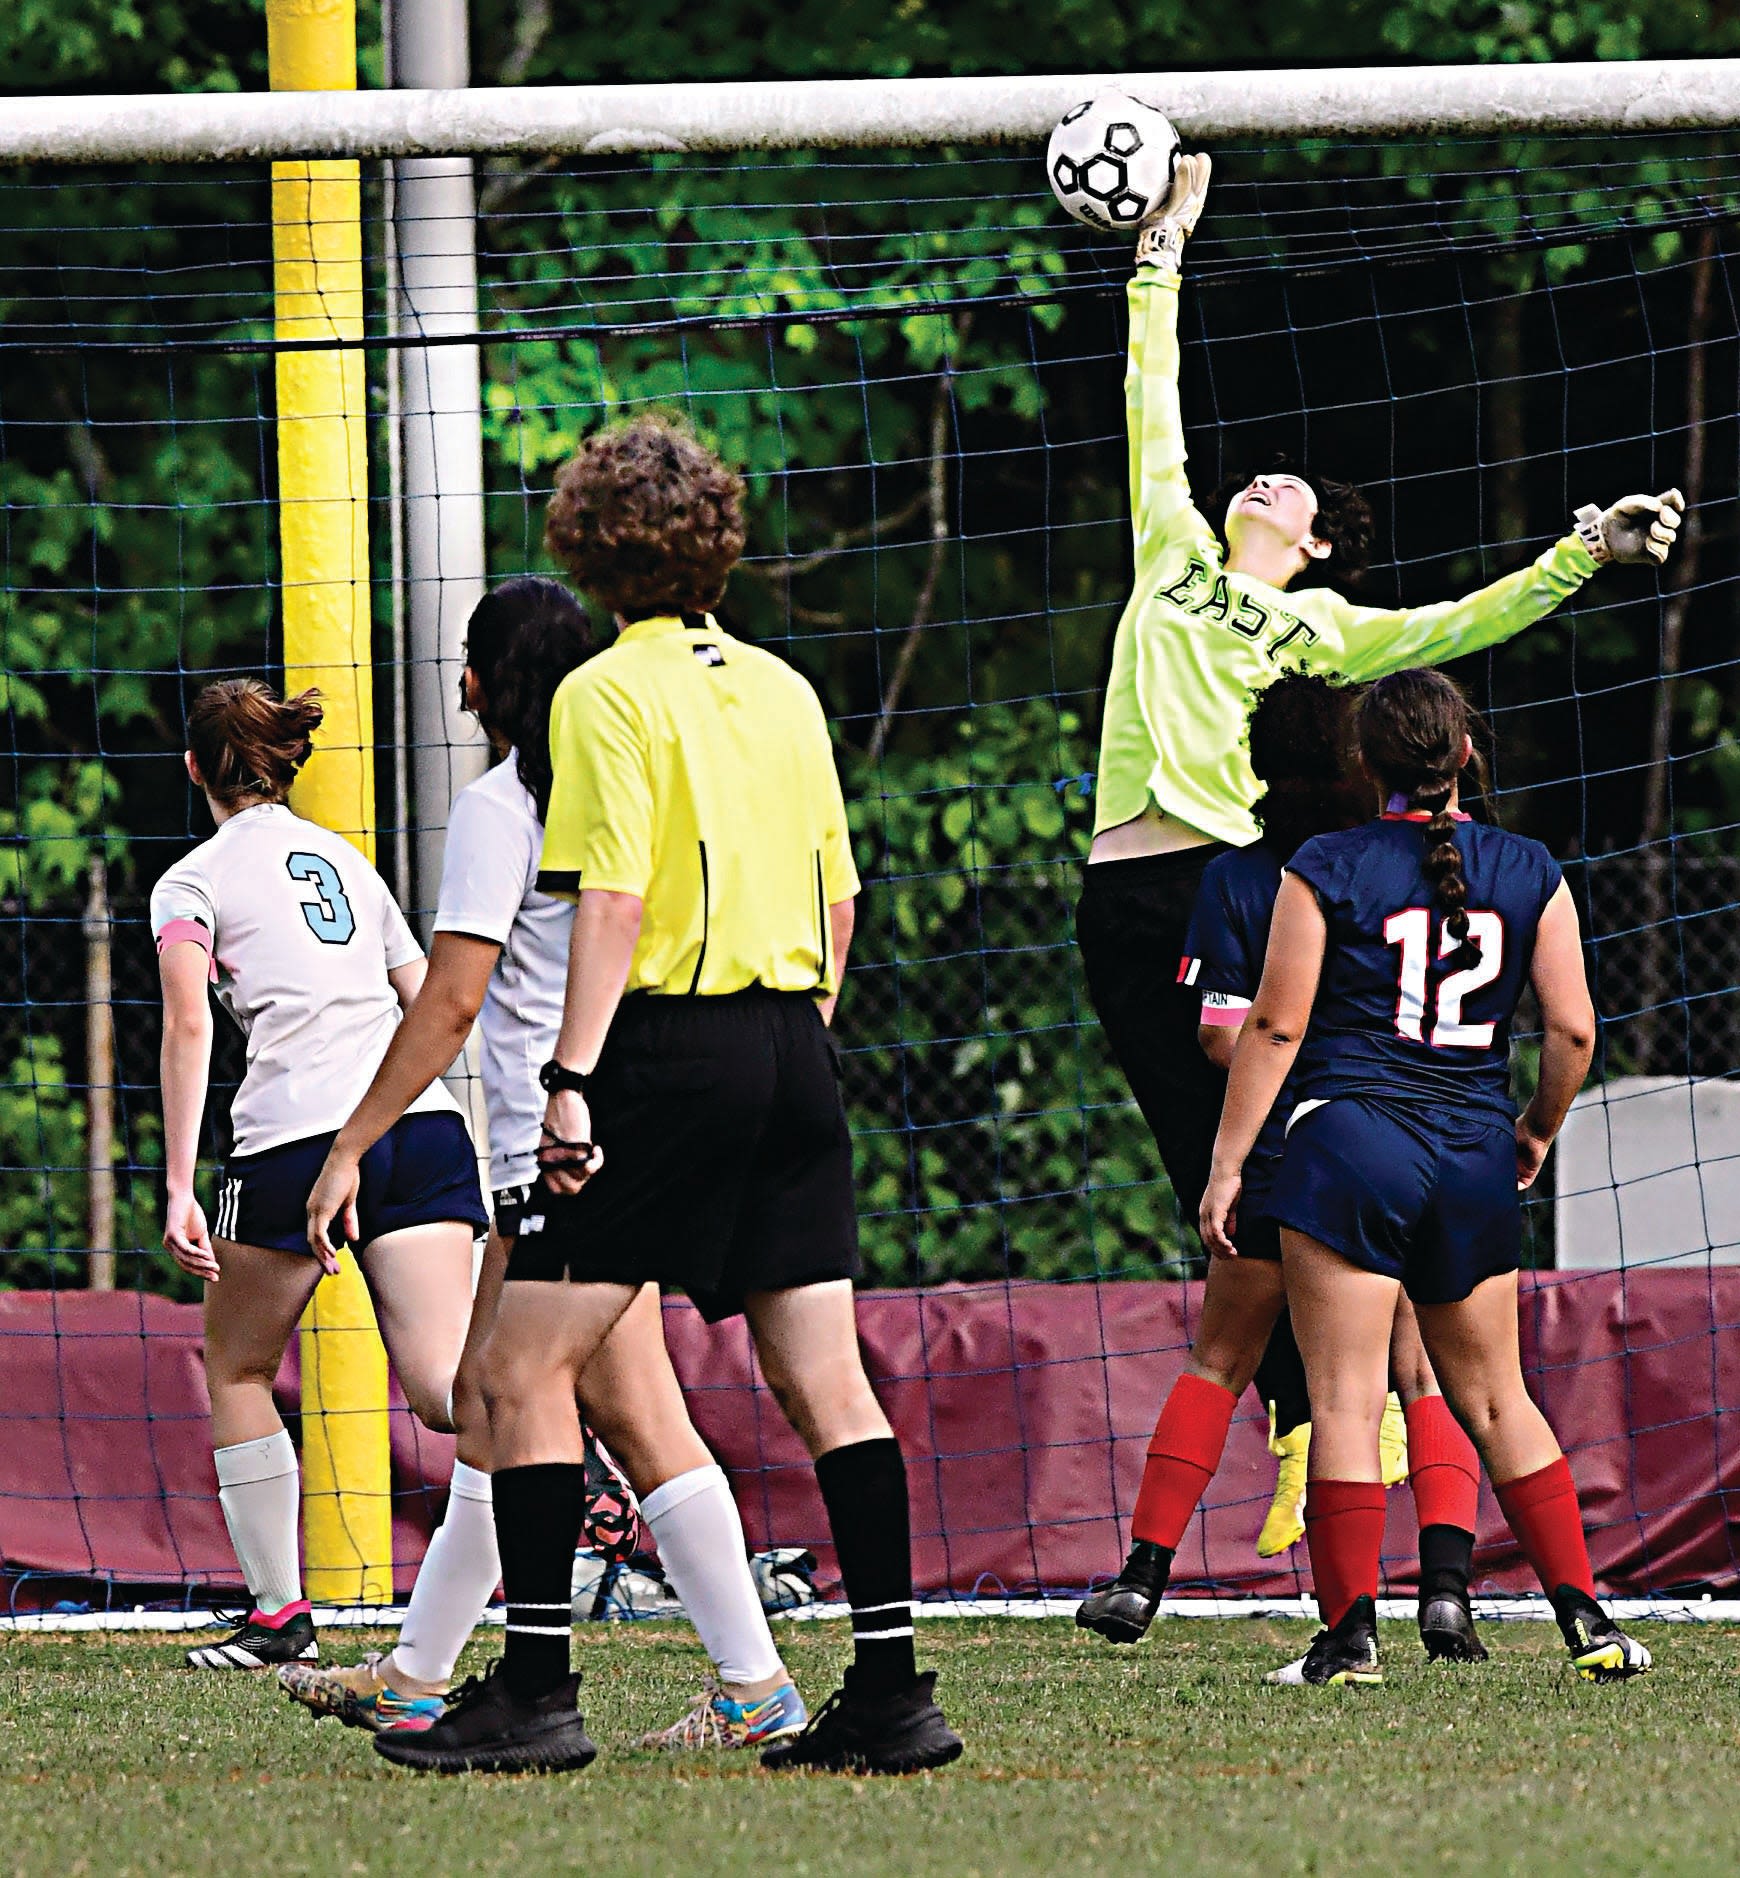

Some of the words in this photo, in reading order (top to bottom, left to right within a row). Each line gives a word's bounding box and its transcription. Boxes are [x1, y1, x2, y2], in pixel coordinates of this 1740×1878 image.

[1155, 559, 1319, 664] EAST
[286, 851, 357, 945] 3
[1383, 907, 1504, 1049] 12
